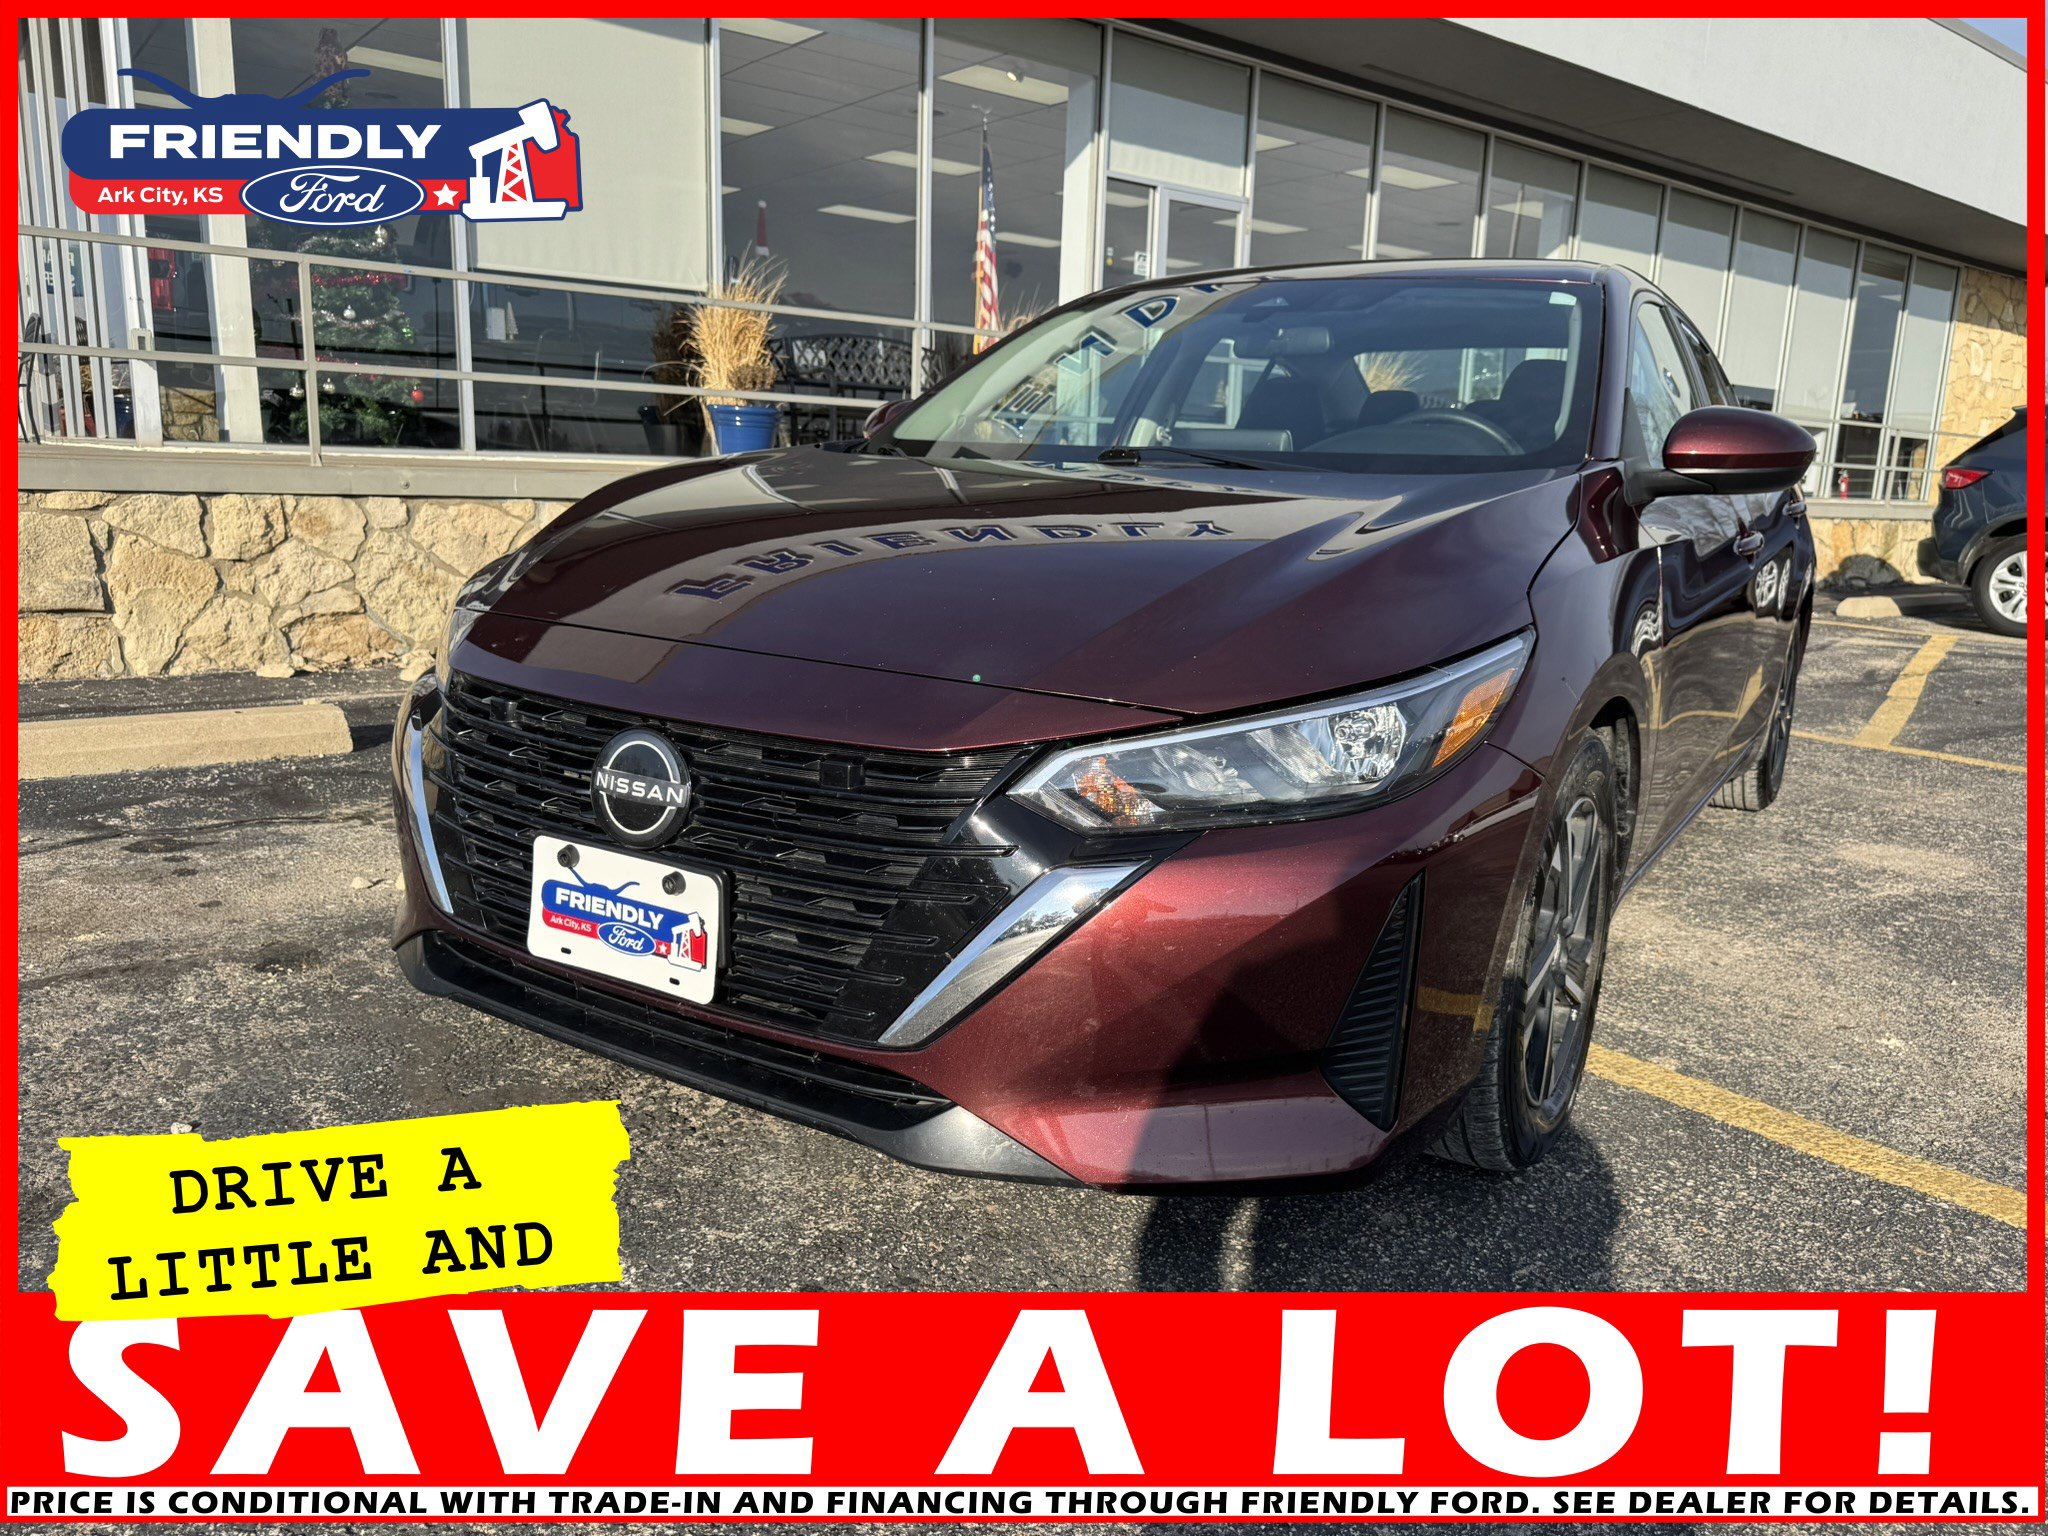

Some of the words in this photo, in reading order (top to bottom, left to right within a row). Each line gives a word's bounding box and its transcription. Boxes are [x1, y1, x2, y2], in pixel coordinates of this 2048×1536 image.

[596, 771, 684, 804] NISSAN
[555, 887, 664, 930] FRIENDLY
[550, 915, 564, 925] Ark
[563, 918, 580, 930] City,
[580, 922, 592, 933] KS
[608, 925, 645, 951] Ford
